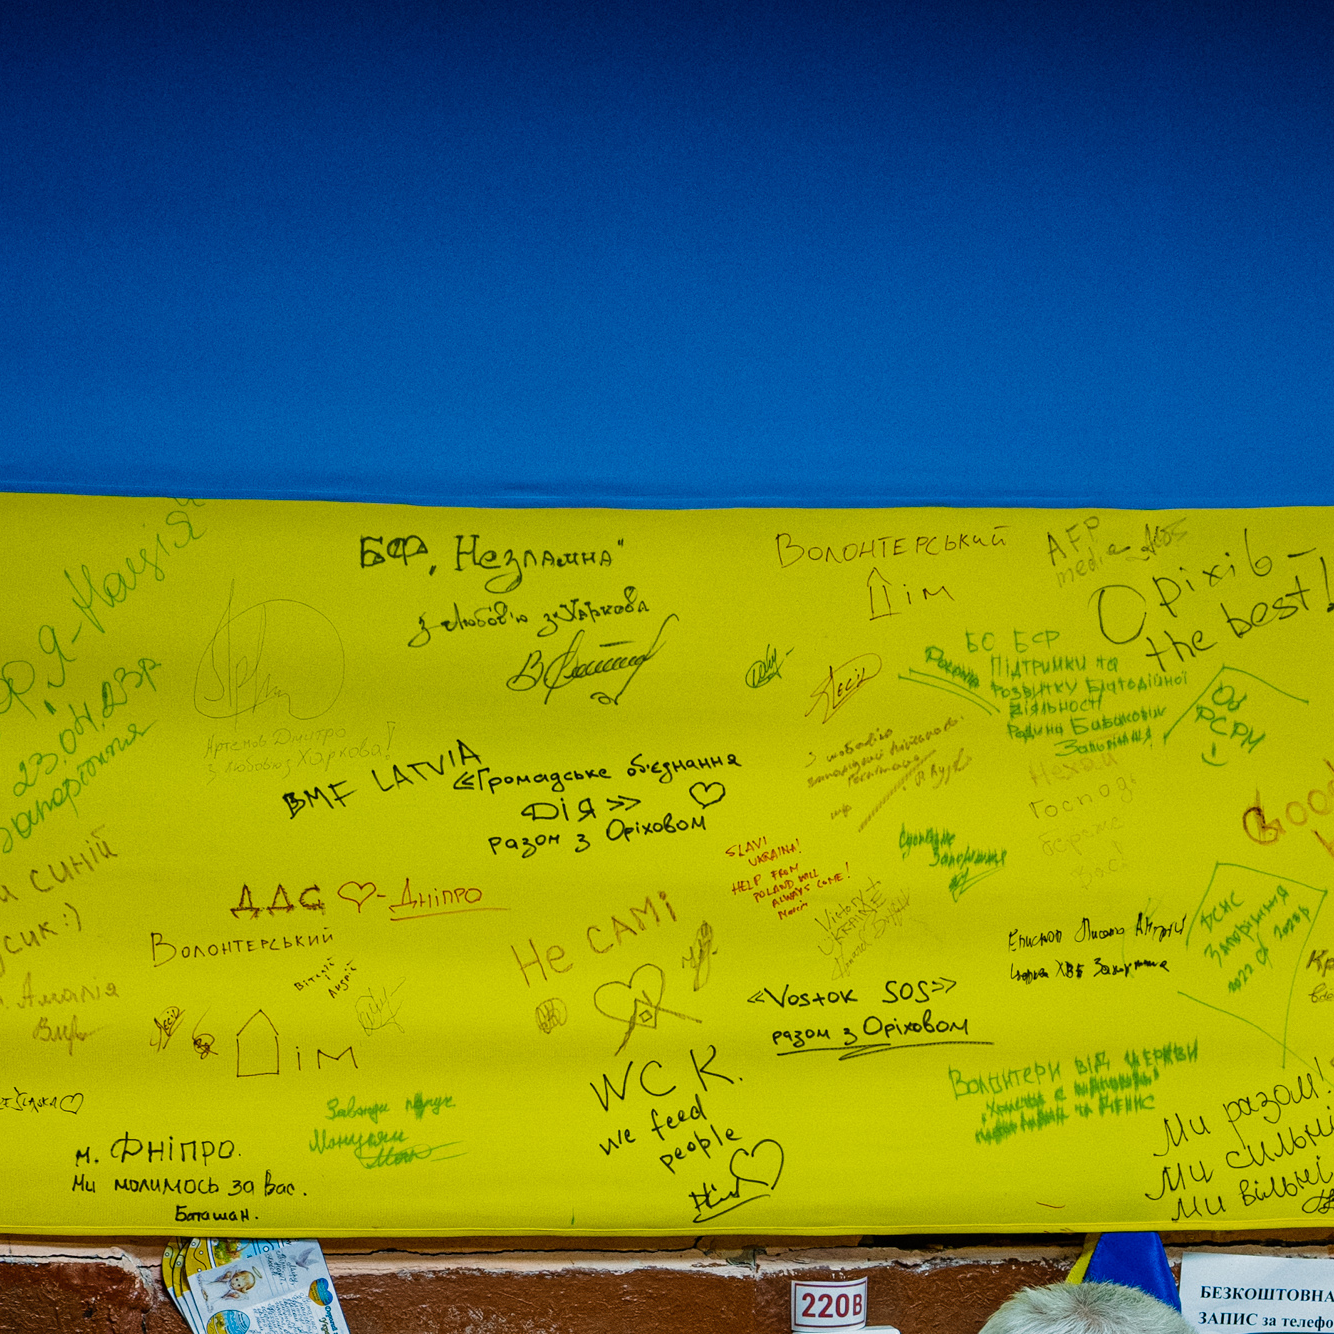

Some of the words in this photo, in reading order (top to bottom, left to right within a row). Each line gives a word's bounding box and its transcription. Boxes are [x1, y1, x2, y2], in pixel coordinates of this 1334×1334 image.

[1146, 629, 1216, 673] the
[371, 739, 483, 793] LATVIA
[731, 873, 763, 897] HELP
[770, 862, 800, 882] FROM
[753, 878, 795, 904] POLAND
[650, 1093, 708, 1141] feed
[660, 1125, 743, 1174] people
[1197, 1311, 1258, 1326] ЗАПИС
[1262, 1317, 1276, 1326] за
